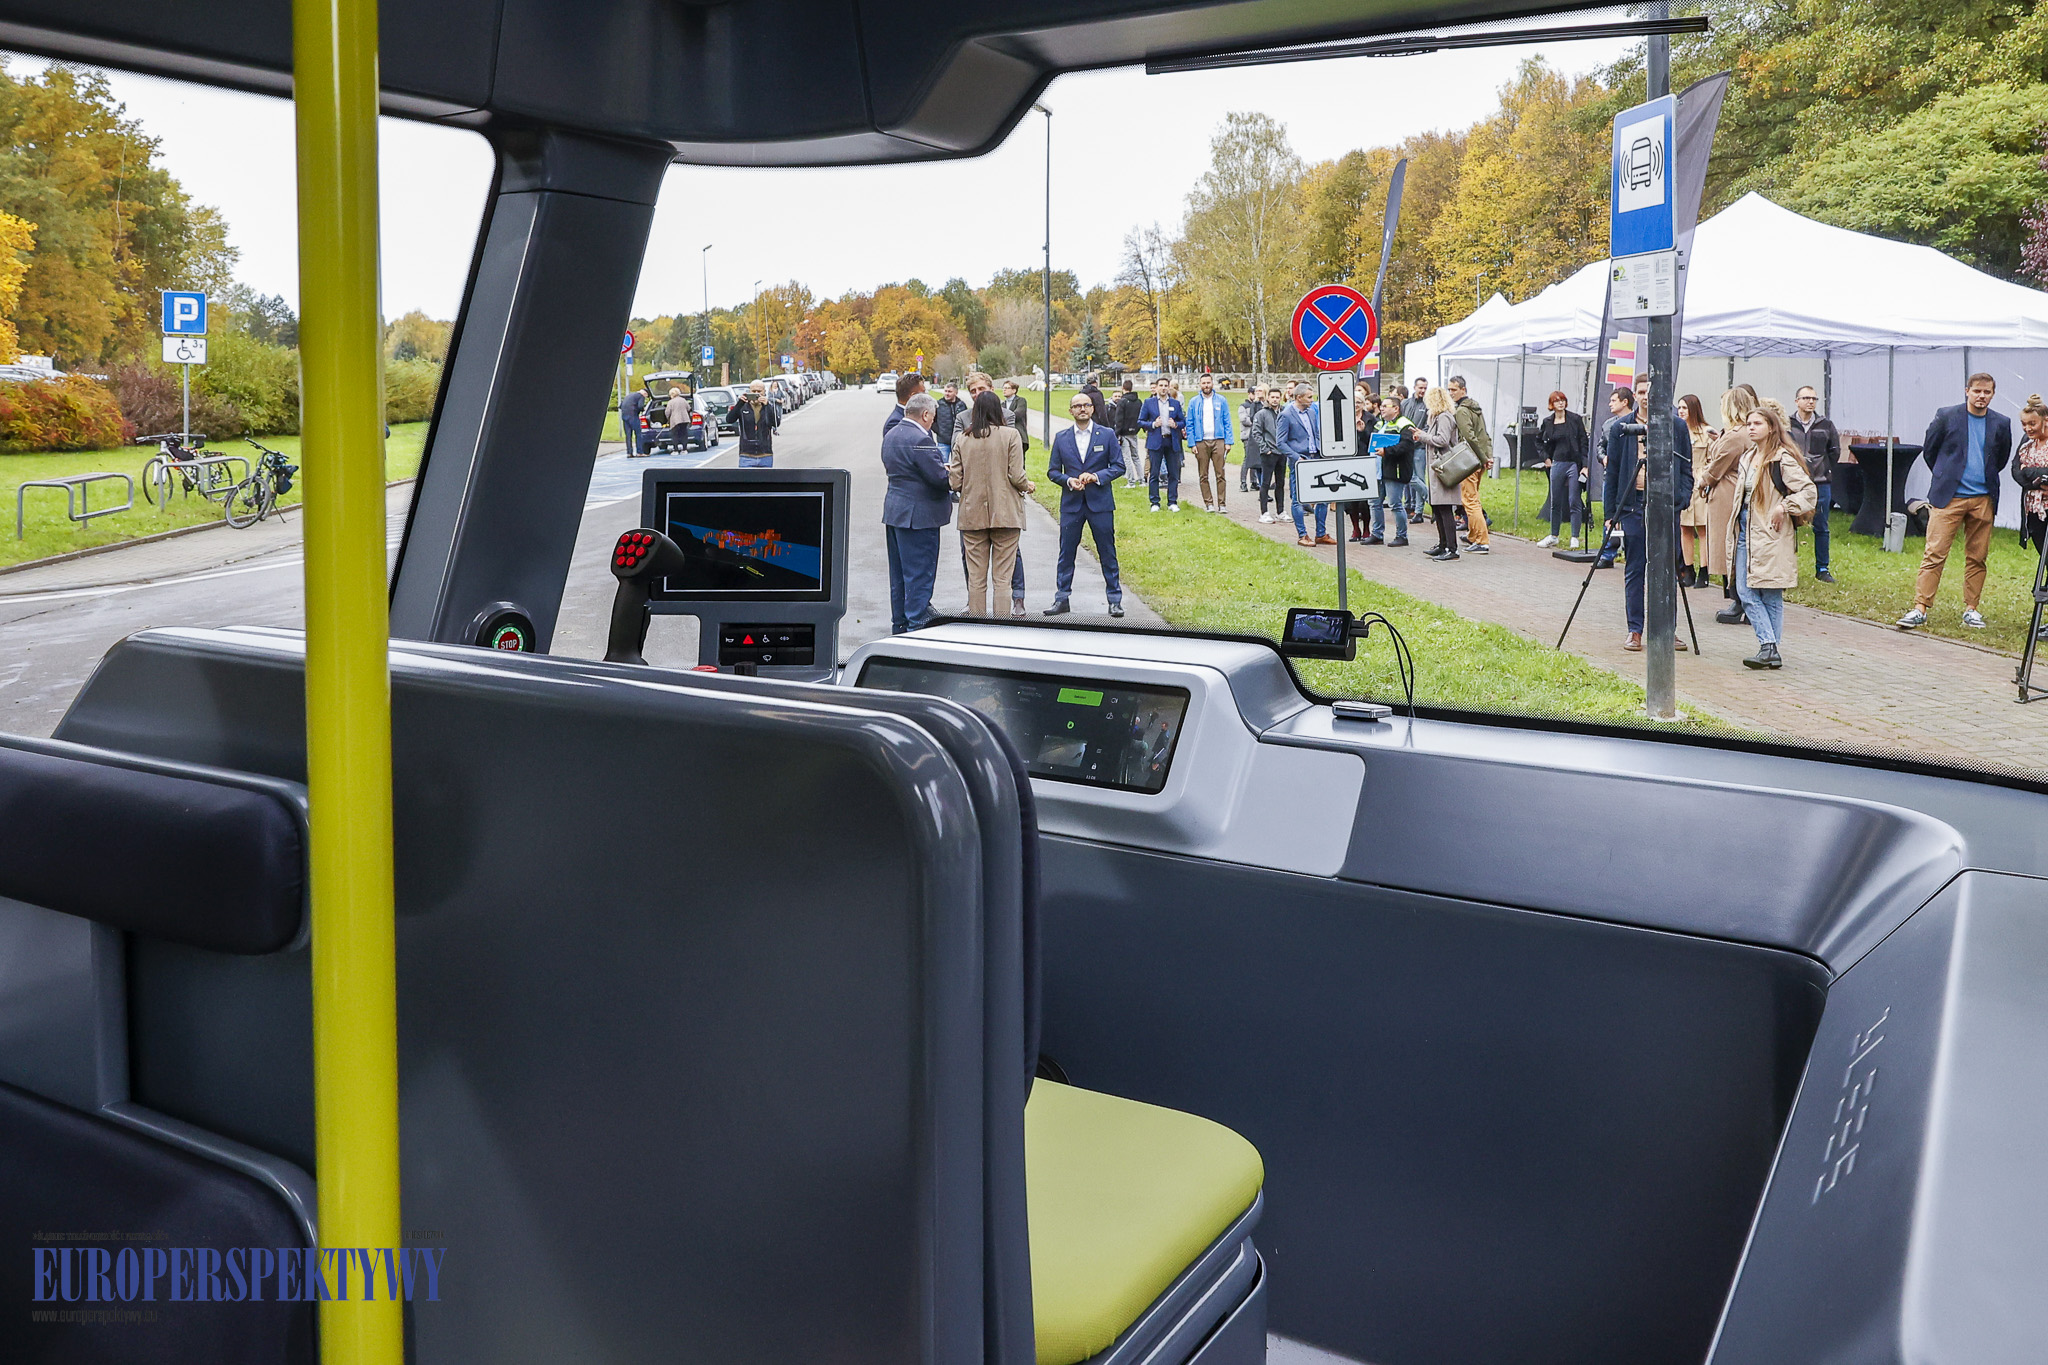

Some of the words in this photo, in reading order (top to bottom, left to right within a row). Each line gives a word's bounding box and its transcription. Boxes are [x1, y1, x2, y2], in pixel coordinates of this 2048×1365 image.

[173, 296, 199, 330] P
[704, 348, 711, 358] P
[501, 639, 518, 650] STOP
